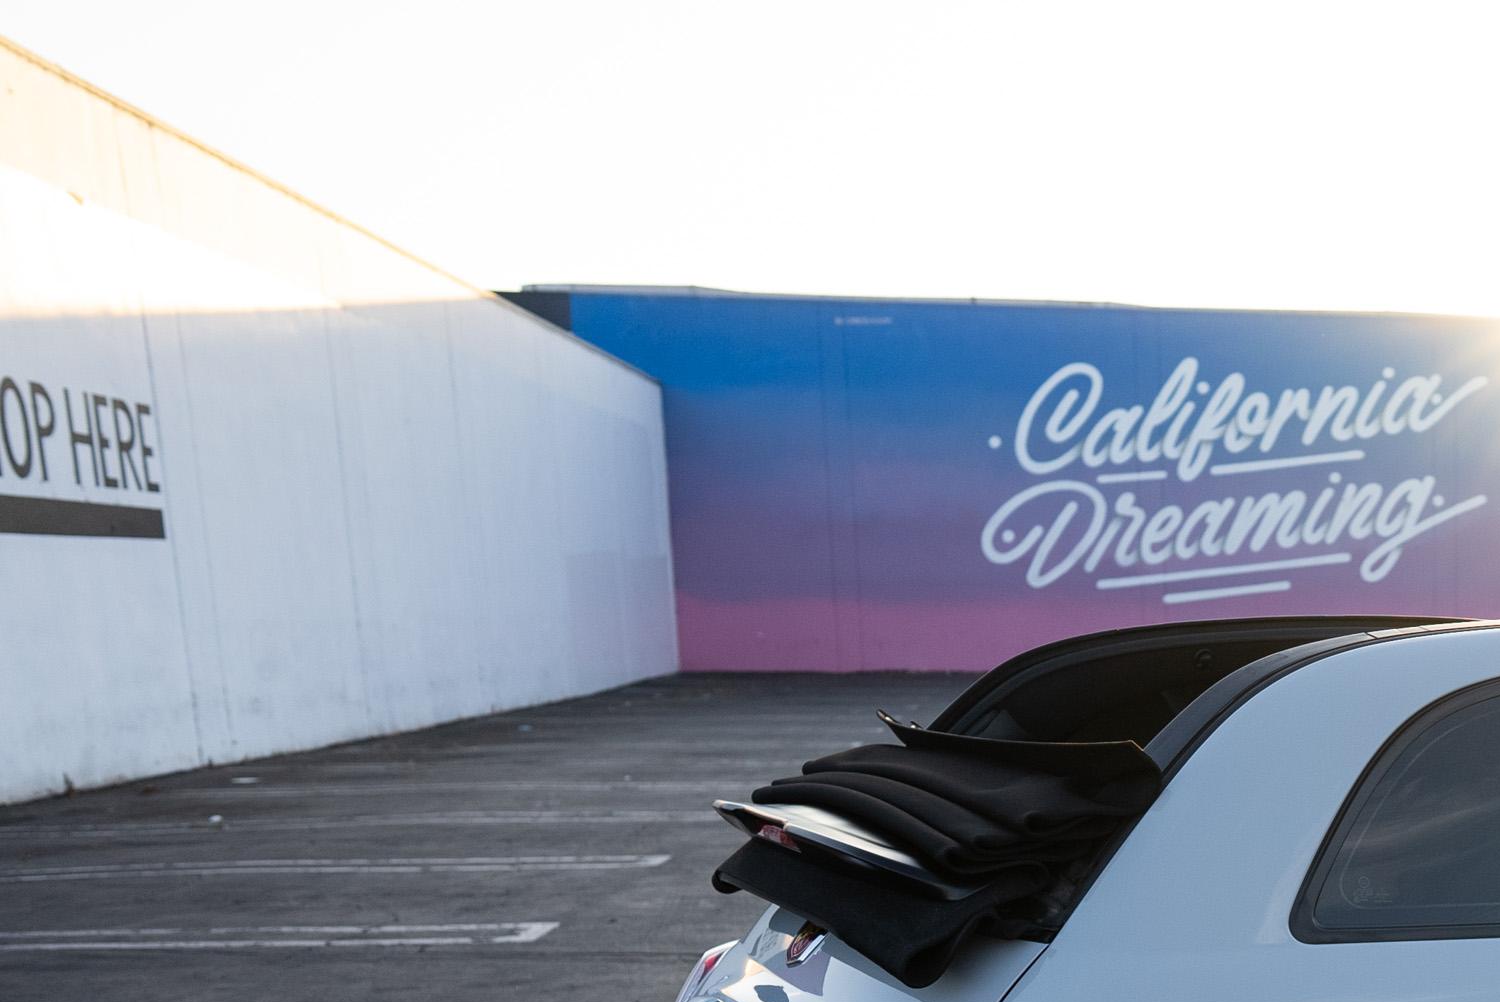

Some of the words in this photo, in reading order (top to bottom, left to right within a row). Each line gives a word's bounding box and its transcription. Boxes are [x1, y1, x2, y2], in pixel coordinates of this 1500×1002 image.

[0, 376, 55, 482] OP
[63, 386, 161, 492] HERE
[1014, 357, 1487, 481] California
[981, 474, 1487, 588] Dreaming
